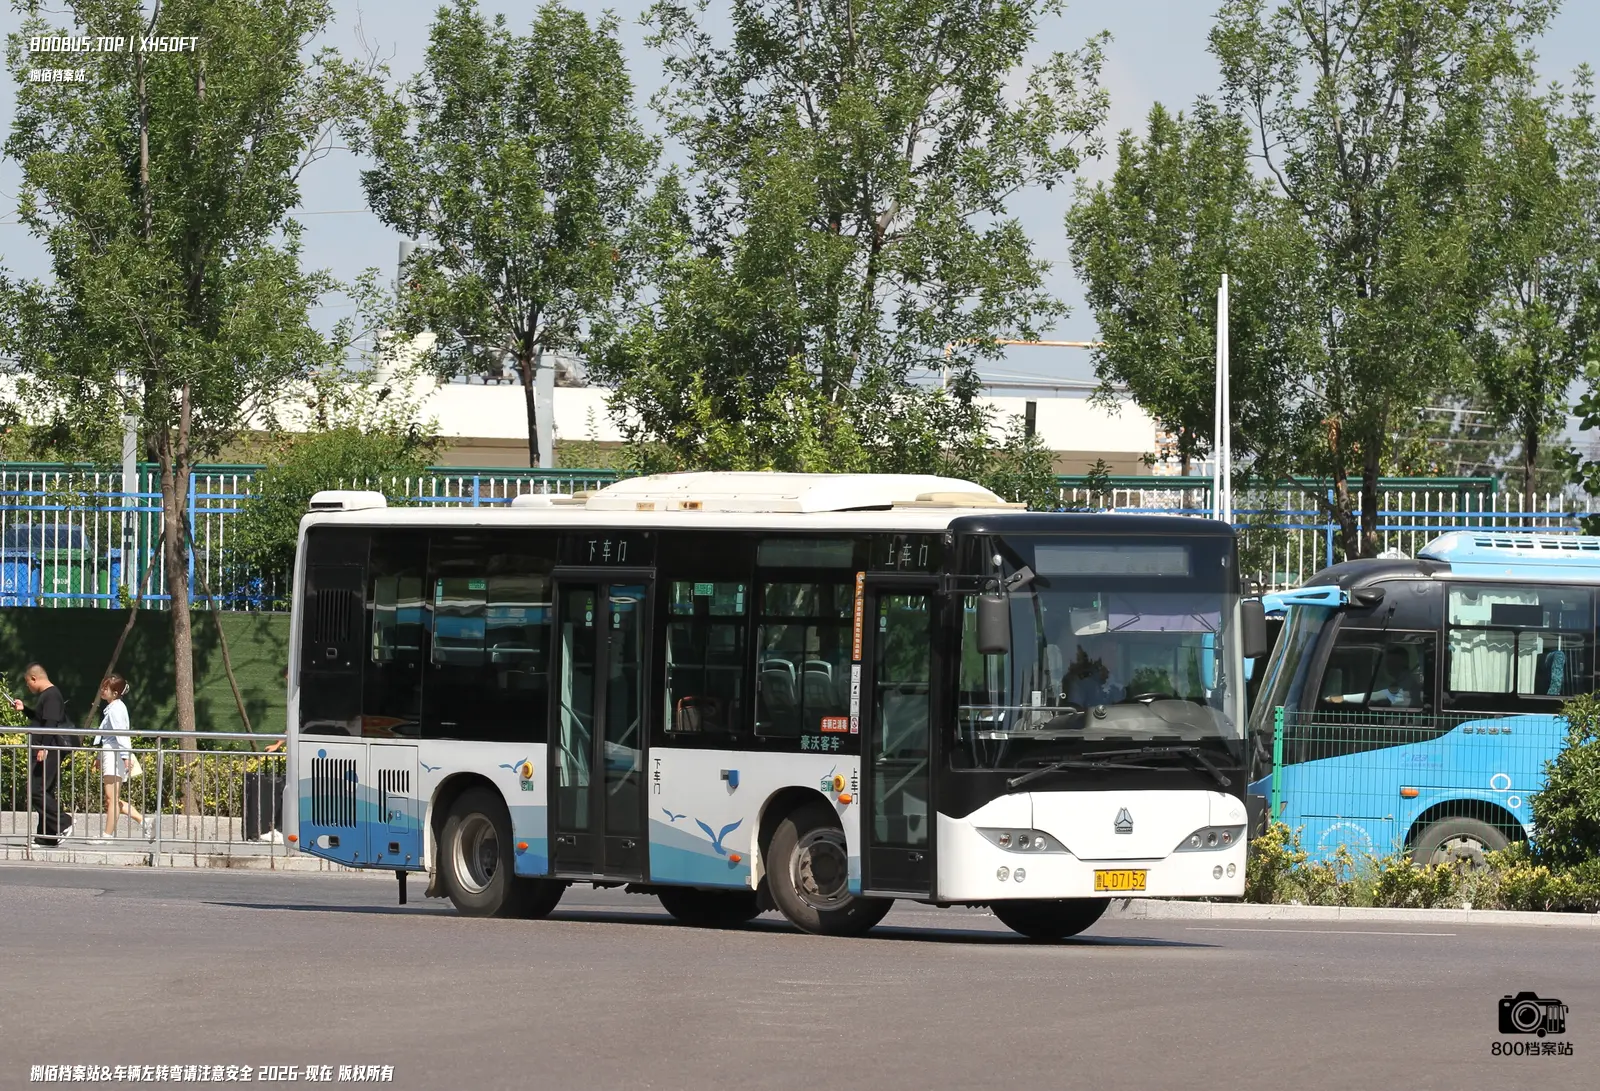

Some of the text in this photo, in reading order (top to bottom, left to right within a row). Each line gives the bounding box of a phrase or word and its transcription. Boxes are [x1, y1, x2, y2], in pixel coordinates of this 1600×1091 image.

[588, 539, 627, 562] 下车门
[885, 543, 928, 567] 上车门
[800, 735, 840, 751] 豪沃客车
[653, 758, 662, 795] 下车门
[850, 767, 859, 805] 上车门
